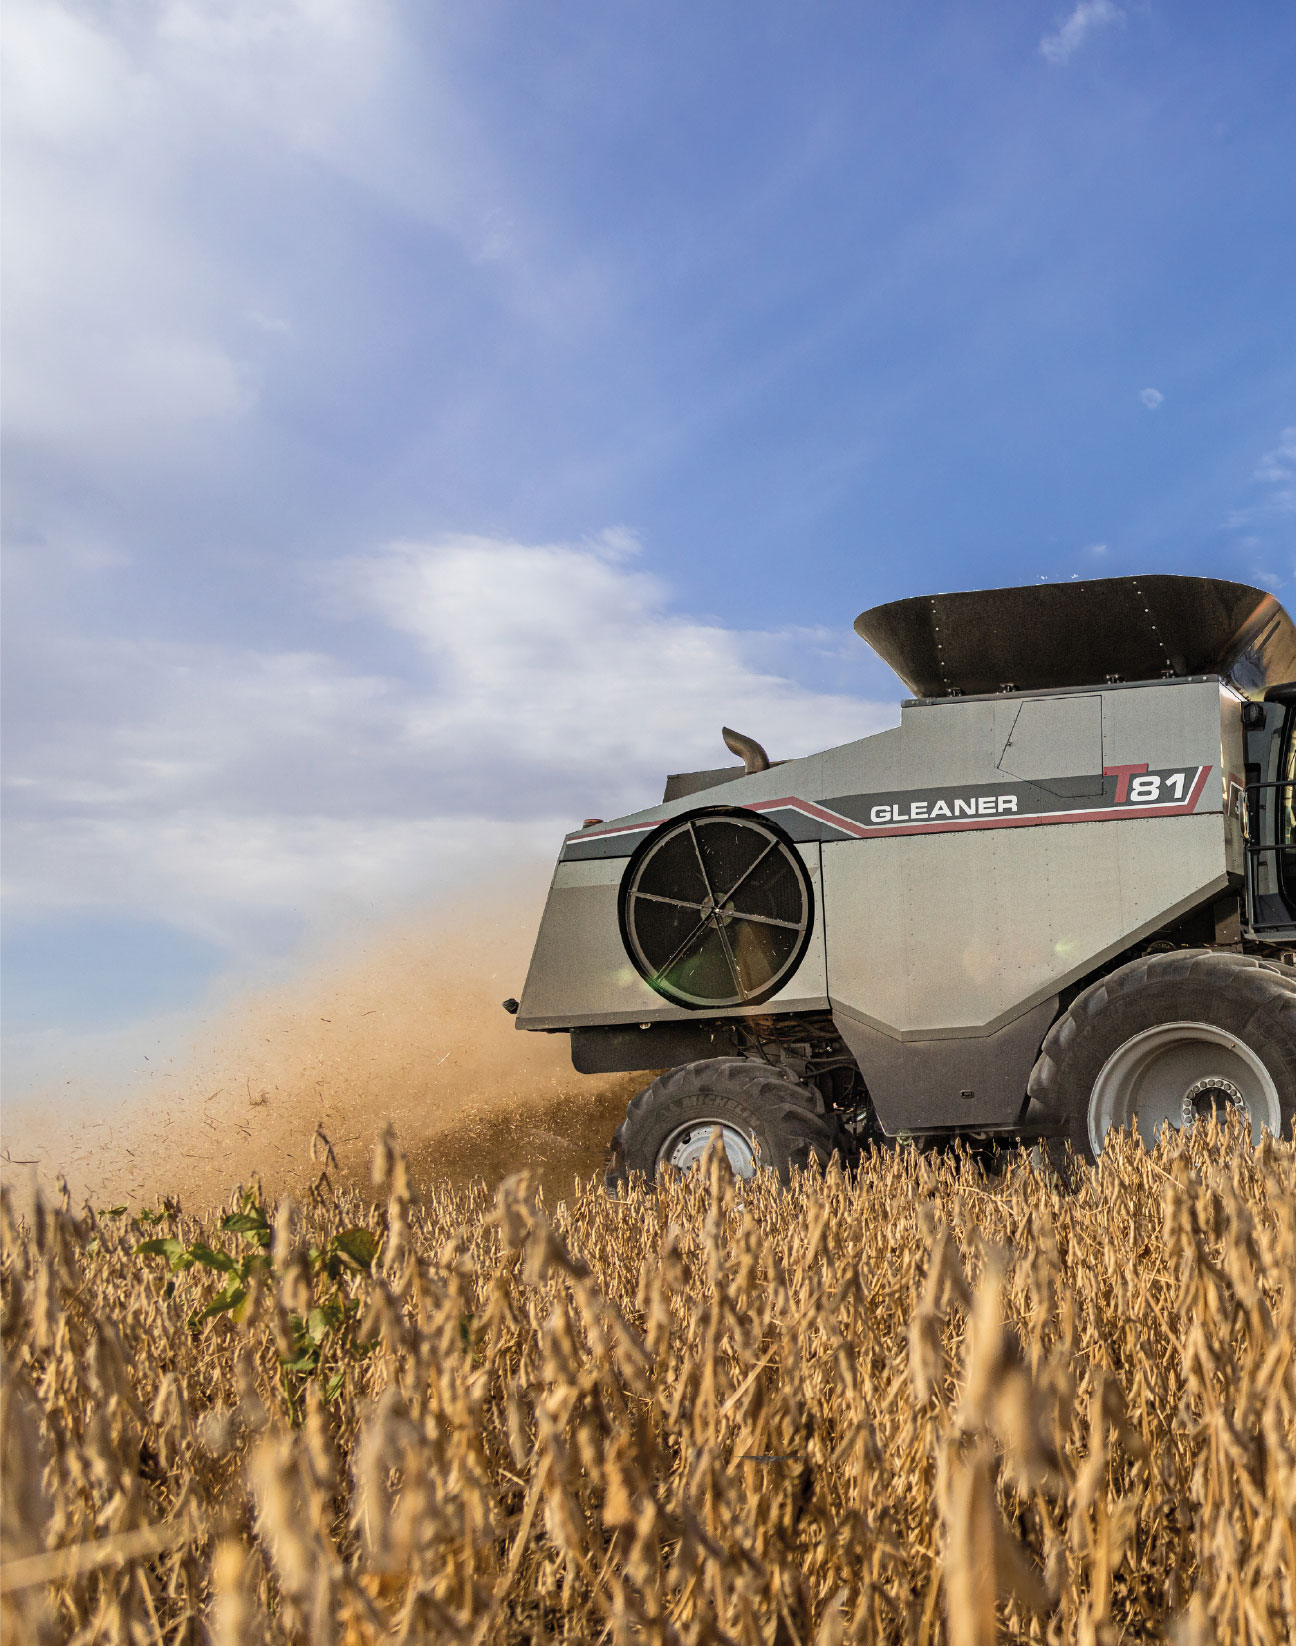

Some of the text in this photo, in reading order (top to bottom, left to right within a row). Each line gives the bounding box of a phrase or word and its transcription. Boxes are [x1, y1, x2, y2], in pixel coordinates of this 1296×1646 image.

[1103, 763, 1185, 803] T81
[871, 795, 1018, 823] GLEANER
[682, 1094, 761, 1126] MICHELIN
